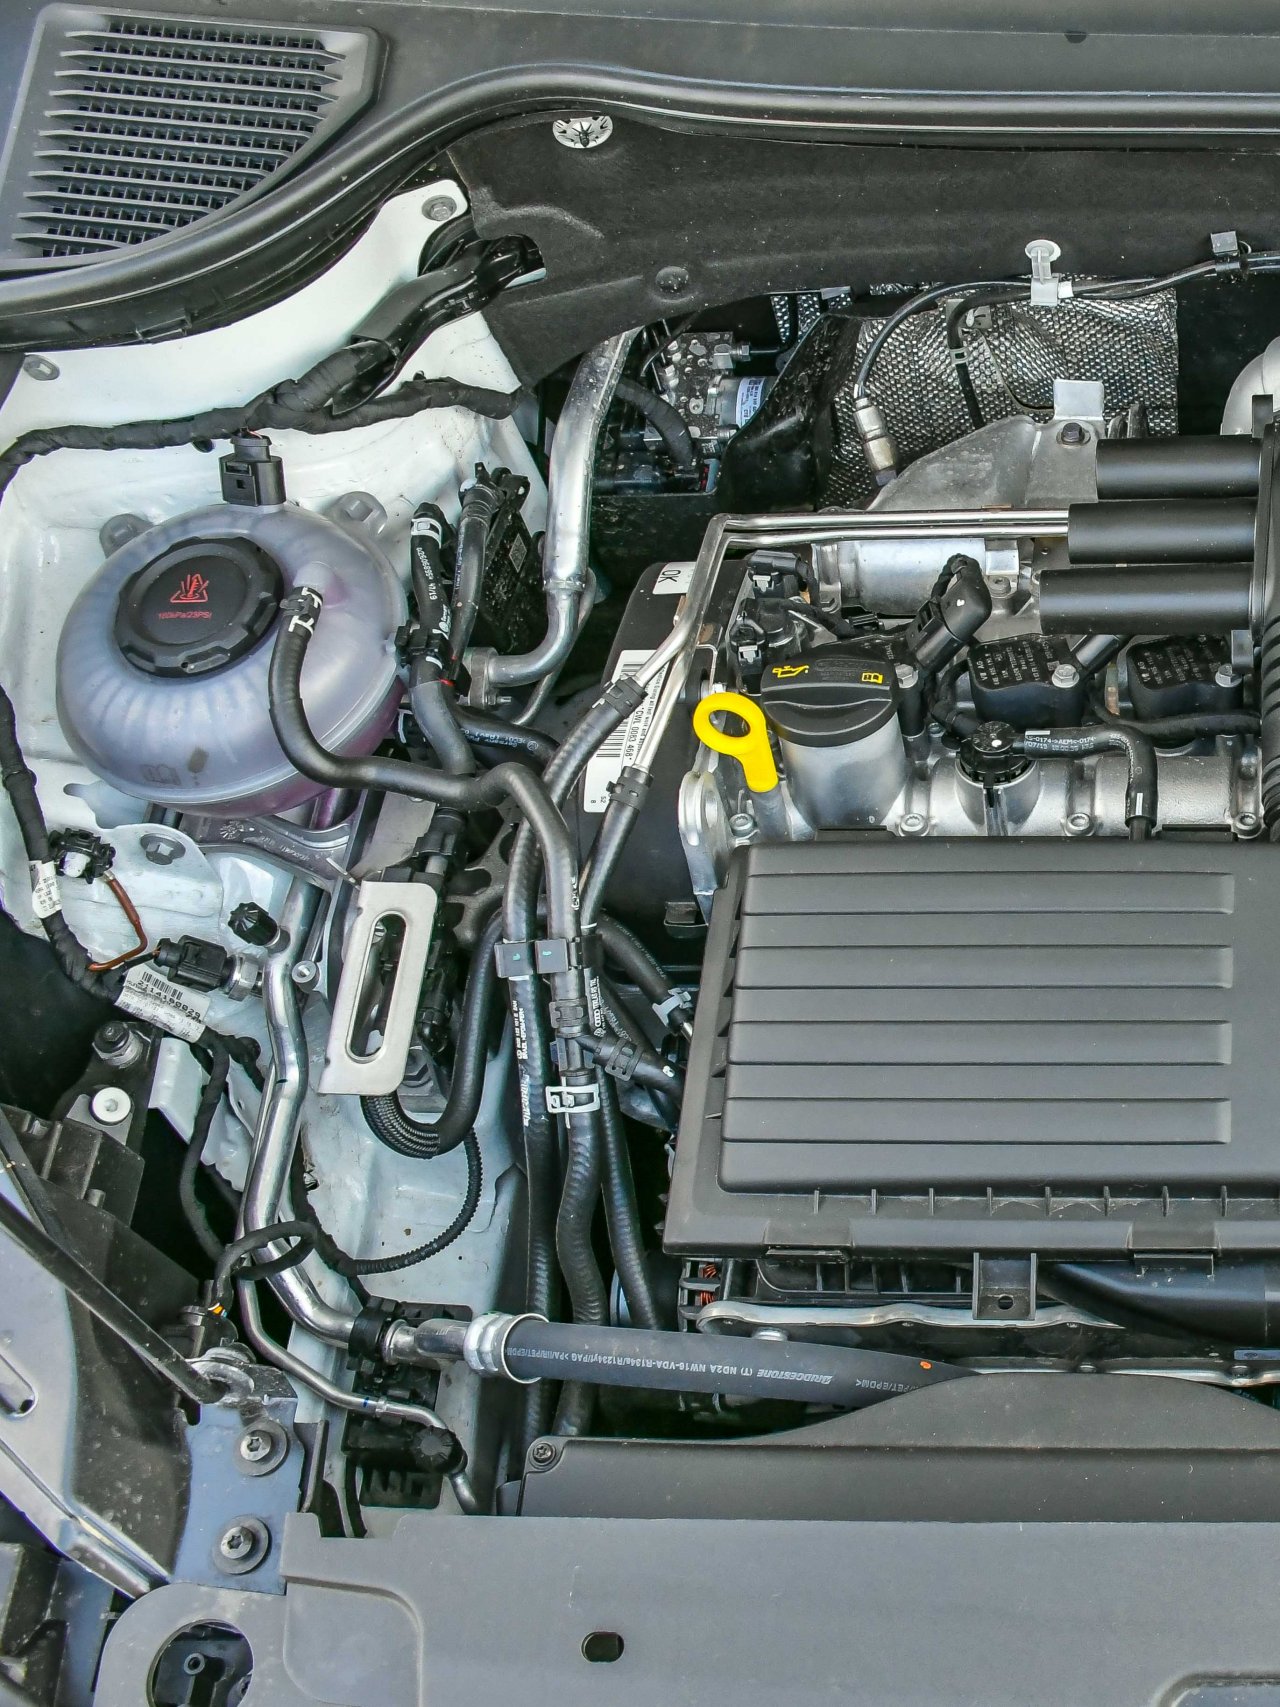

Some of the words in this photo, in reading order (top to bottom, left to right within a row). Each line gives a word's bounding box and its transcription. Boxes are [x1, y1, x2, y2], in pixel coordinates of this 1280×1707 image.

[658, 569, 681, 583] OK
[710, 1365, 737, 1375] ND2A
[741, 1367, 753, 1376] (T)
[757, 1369, 833, 1385] BRIDGESTONE
